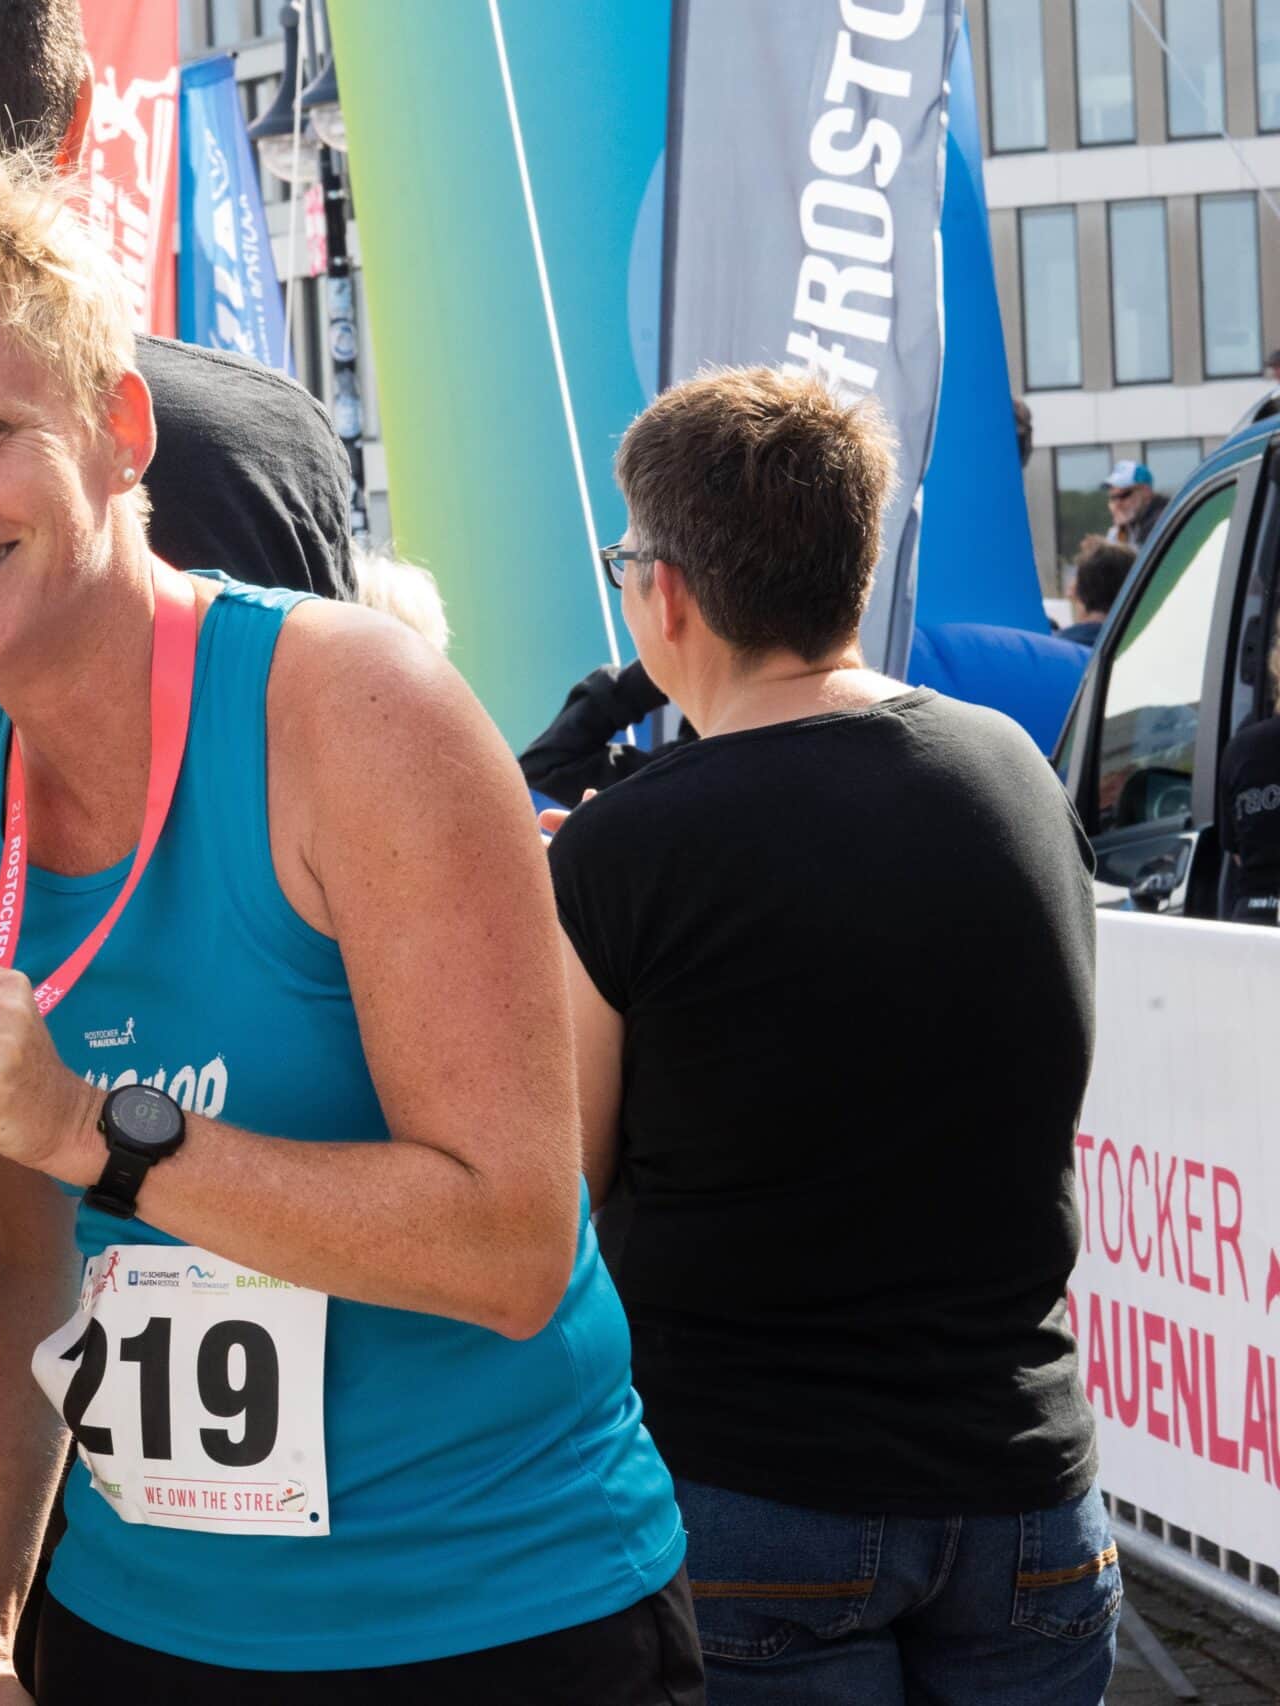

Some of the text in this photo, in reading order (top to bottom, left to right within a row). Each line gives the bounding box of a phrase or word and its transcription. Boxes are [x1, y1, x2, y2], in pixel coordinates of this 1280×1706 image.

[10, 799, 22, 831] 21.
[84, 1028, 118, 1040] ROSTOCKER
[89, 1036, 129, 1048] FRAUENLAUF
[1074, 1132, 1249, 1303] TOCKER
[139, 1279, 157, 1287] HAFEN
[59, 1316, 280, 1468] 219
[144, 1485, 162, 1505] WE
[169, 1487, 197, 1508] OWN
[202, 1490, 227, 1510] THE
